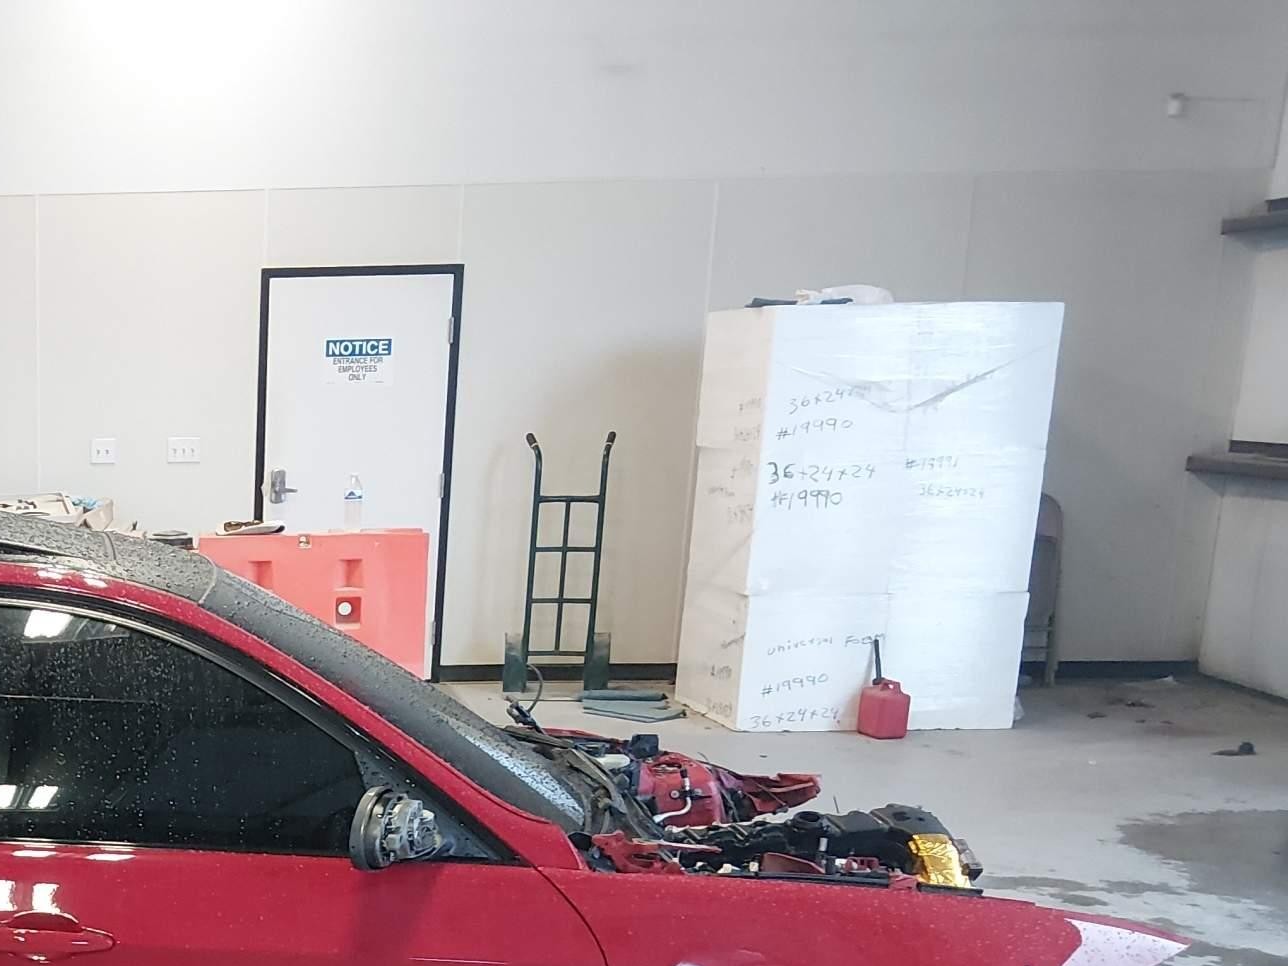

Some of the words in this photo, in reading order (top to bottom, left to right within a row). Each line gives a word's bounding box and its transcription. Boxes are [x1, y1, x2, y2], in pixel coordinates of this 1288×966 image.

[328, 340, 389, 356] NOTICE
[333, 357, 368, 365] ENTRANCE
[369, 356, 383, 364] FOR
[338, 365, 377, 373] EMPLOYEES
[348, 373, 366, 381] ONLY
